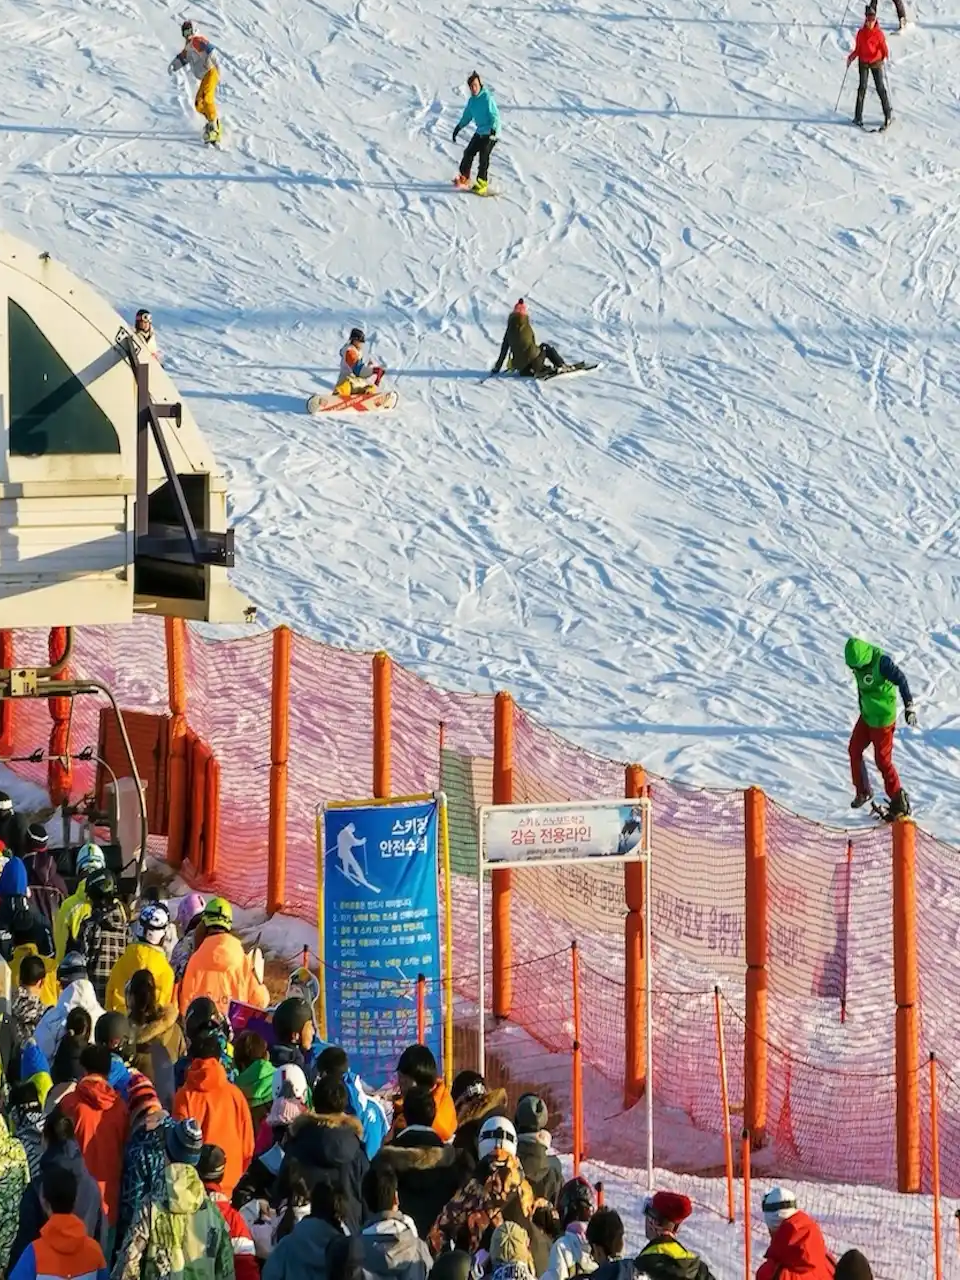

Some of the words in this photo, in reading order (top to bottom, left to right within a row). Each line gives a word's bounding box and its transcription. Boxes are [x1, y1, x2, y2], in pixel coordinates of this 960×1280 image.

[391, 816, 428, 836] 스키장
[511, 829, 537, 846] 강습
[540, 826, 592, 845] 전용라인
